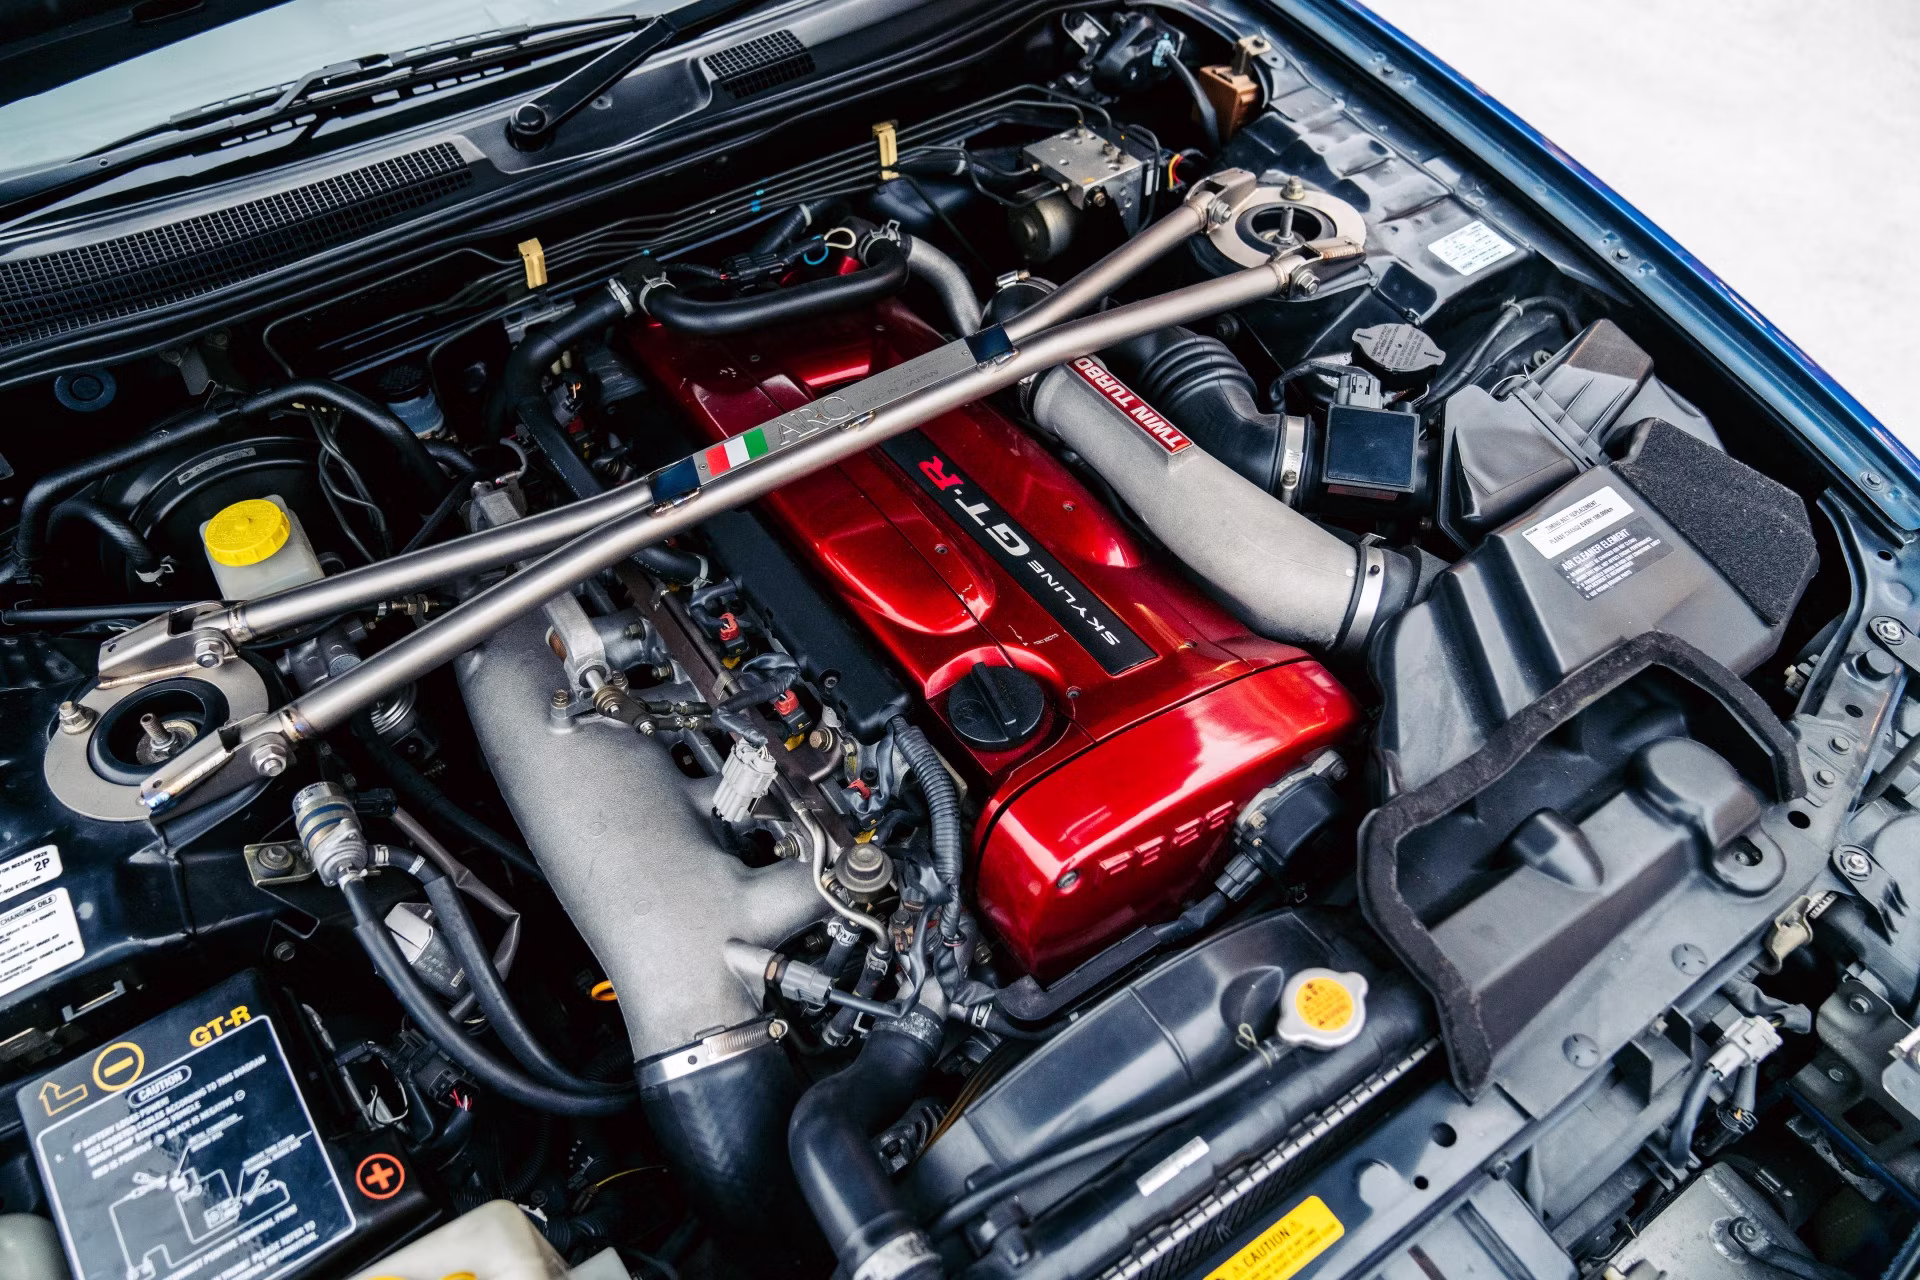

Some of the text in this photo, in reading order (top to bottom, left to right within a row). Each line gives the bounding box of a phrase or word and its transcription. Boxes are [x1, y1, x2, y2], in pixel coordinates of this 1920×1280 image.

[778, 396, 856, 446] ARC
[1074, 356, 1182, 448] TWIN TURBO
[1568, 500, 1598, 518] REPLACEMENT
[1578, 517, 1594, 527] EVERY
[1561, 559, 1577, 572] AIR
[1572, 543, 1605, 565] CLEANER
[1599, 528, 1630, 549] ELEMENT
[1027, 559, 1120, 646] SKYLINE
[34, 858, 50, 872] 2P
[0, 897, 53, 926] CHANGING OILS
[189, 1005, 251, 1047] GT-R
[138, 1070, 183, 1102] CAUTION
[166, 1119, 192, 1139] BLACK
[197, 1095, 235, 1120] NEGATIVE
[1243, 1228, 1290, 1268] CAUTION
